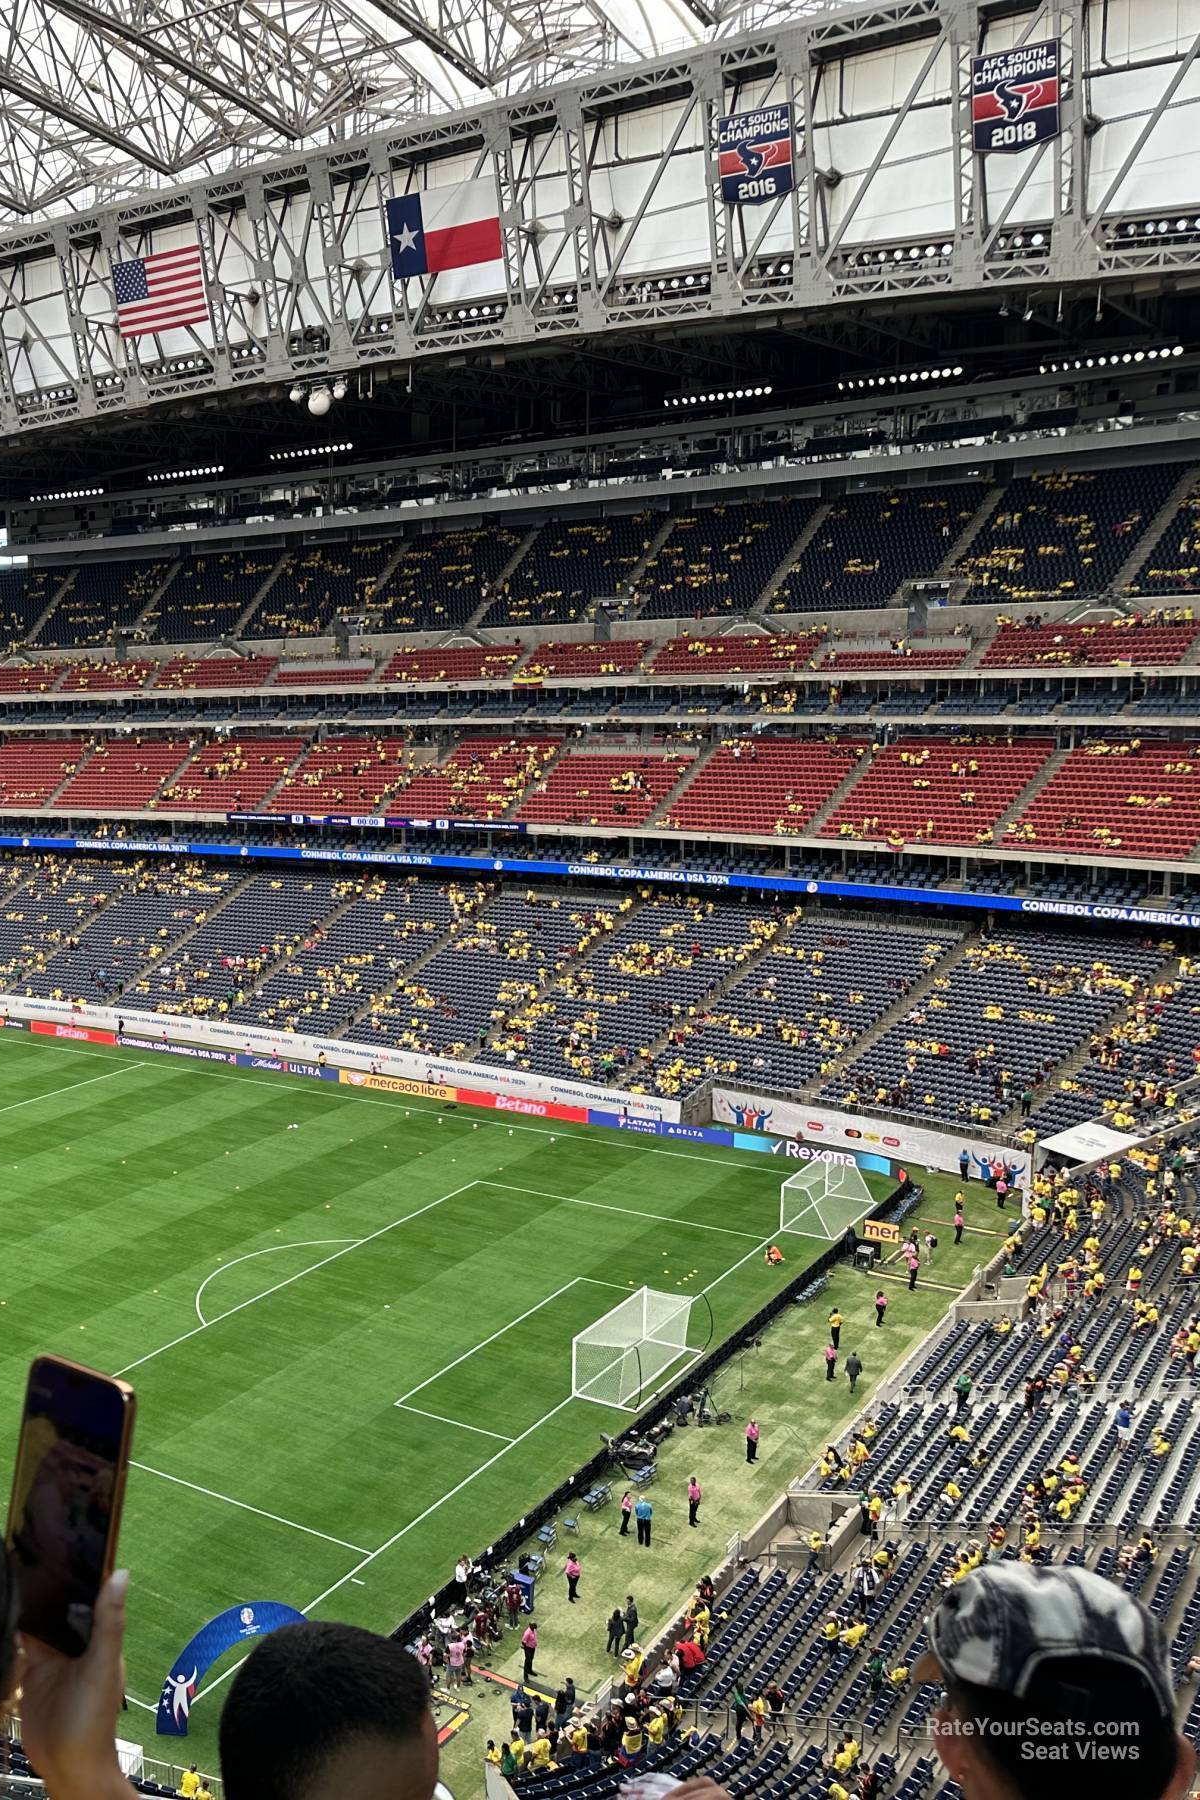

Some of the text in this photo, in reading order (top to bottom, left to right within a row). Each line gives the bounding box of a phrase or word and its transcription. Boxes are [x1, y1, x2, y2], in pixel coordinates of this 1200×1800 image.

[983, 46, 1047, 71] AFC SOUTH
[973, 55, 1056, 86] CHAMPIONS
[720, 118, 788, 143] CHAMPIONS
[727, 109, 781, 131] AFC SOUTH
[991, 121, 1037, 147] 2018
[738, 177, 776, 200] 2016
[76, 840, 110, 849] CONMEBOL
[128, 843, 157, 851] AMERICA
[301, 850, 432, 864] CONMEBOL COPA AMERICA USA 2024
[568, 865, 729, 884] CONMEBOL COPA AMERICA USA 2024
[1022, 900, 1091, 917] CONMEBOL
[1093, 906, 1128, 920] COPA
[1129, 910, 1188, 926] AMERICA
[121, 1037, 154, 1049] CONMEBOL
[153, 1042, 170, 1052] COPA
[169, 1045, 197, 1056] AMERICA
[249, 1033, 271, 1041] AMERICA
[313, 1043, 340, 1053] CONMEBOL
[341, 1046, 356, 1055] COPA
[356, 1050, 379, 1059] AMERICA
[289, 1064, 321, 1077] ULTRA
[425, 1062, 457, 1073] CONMEBOL
[457, 1067, 473, 1076] COPA
[473, 1071, 498, 1080] AMERICA
[370, 1077, 447, 1098] mercado libre
[496, 1094, 547, 1116] Betano
[550, 1085, 662, 1112] CONMEBOL COPA AMERICA USA 2024
[627, 1117, 656, 1129] LATAM
[676, 1127, 704, 1138] DELTA
[785, 1140, 856, 1168] Rexona
